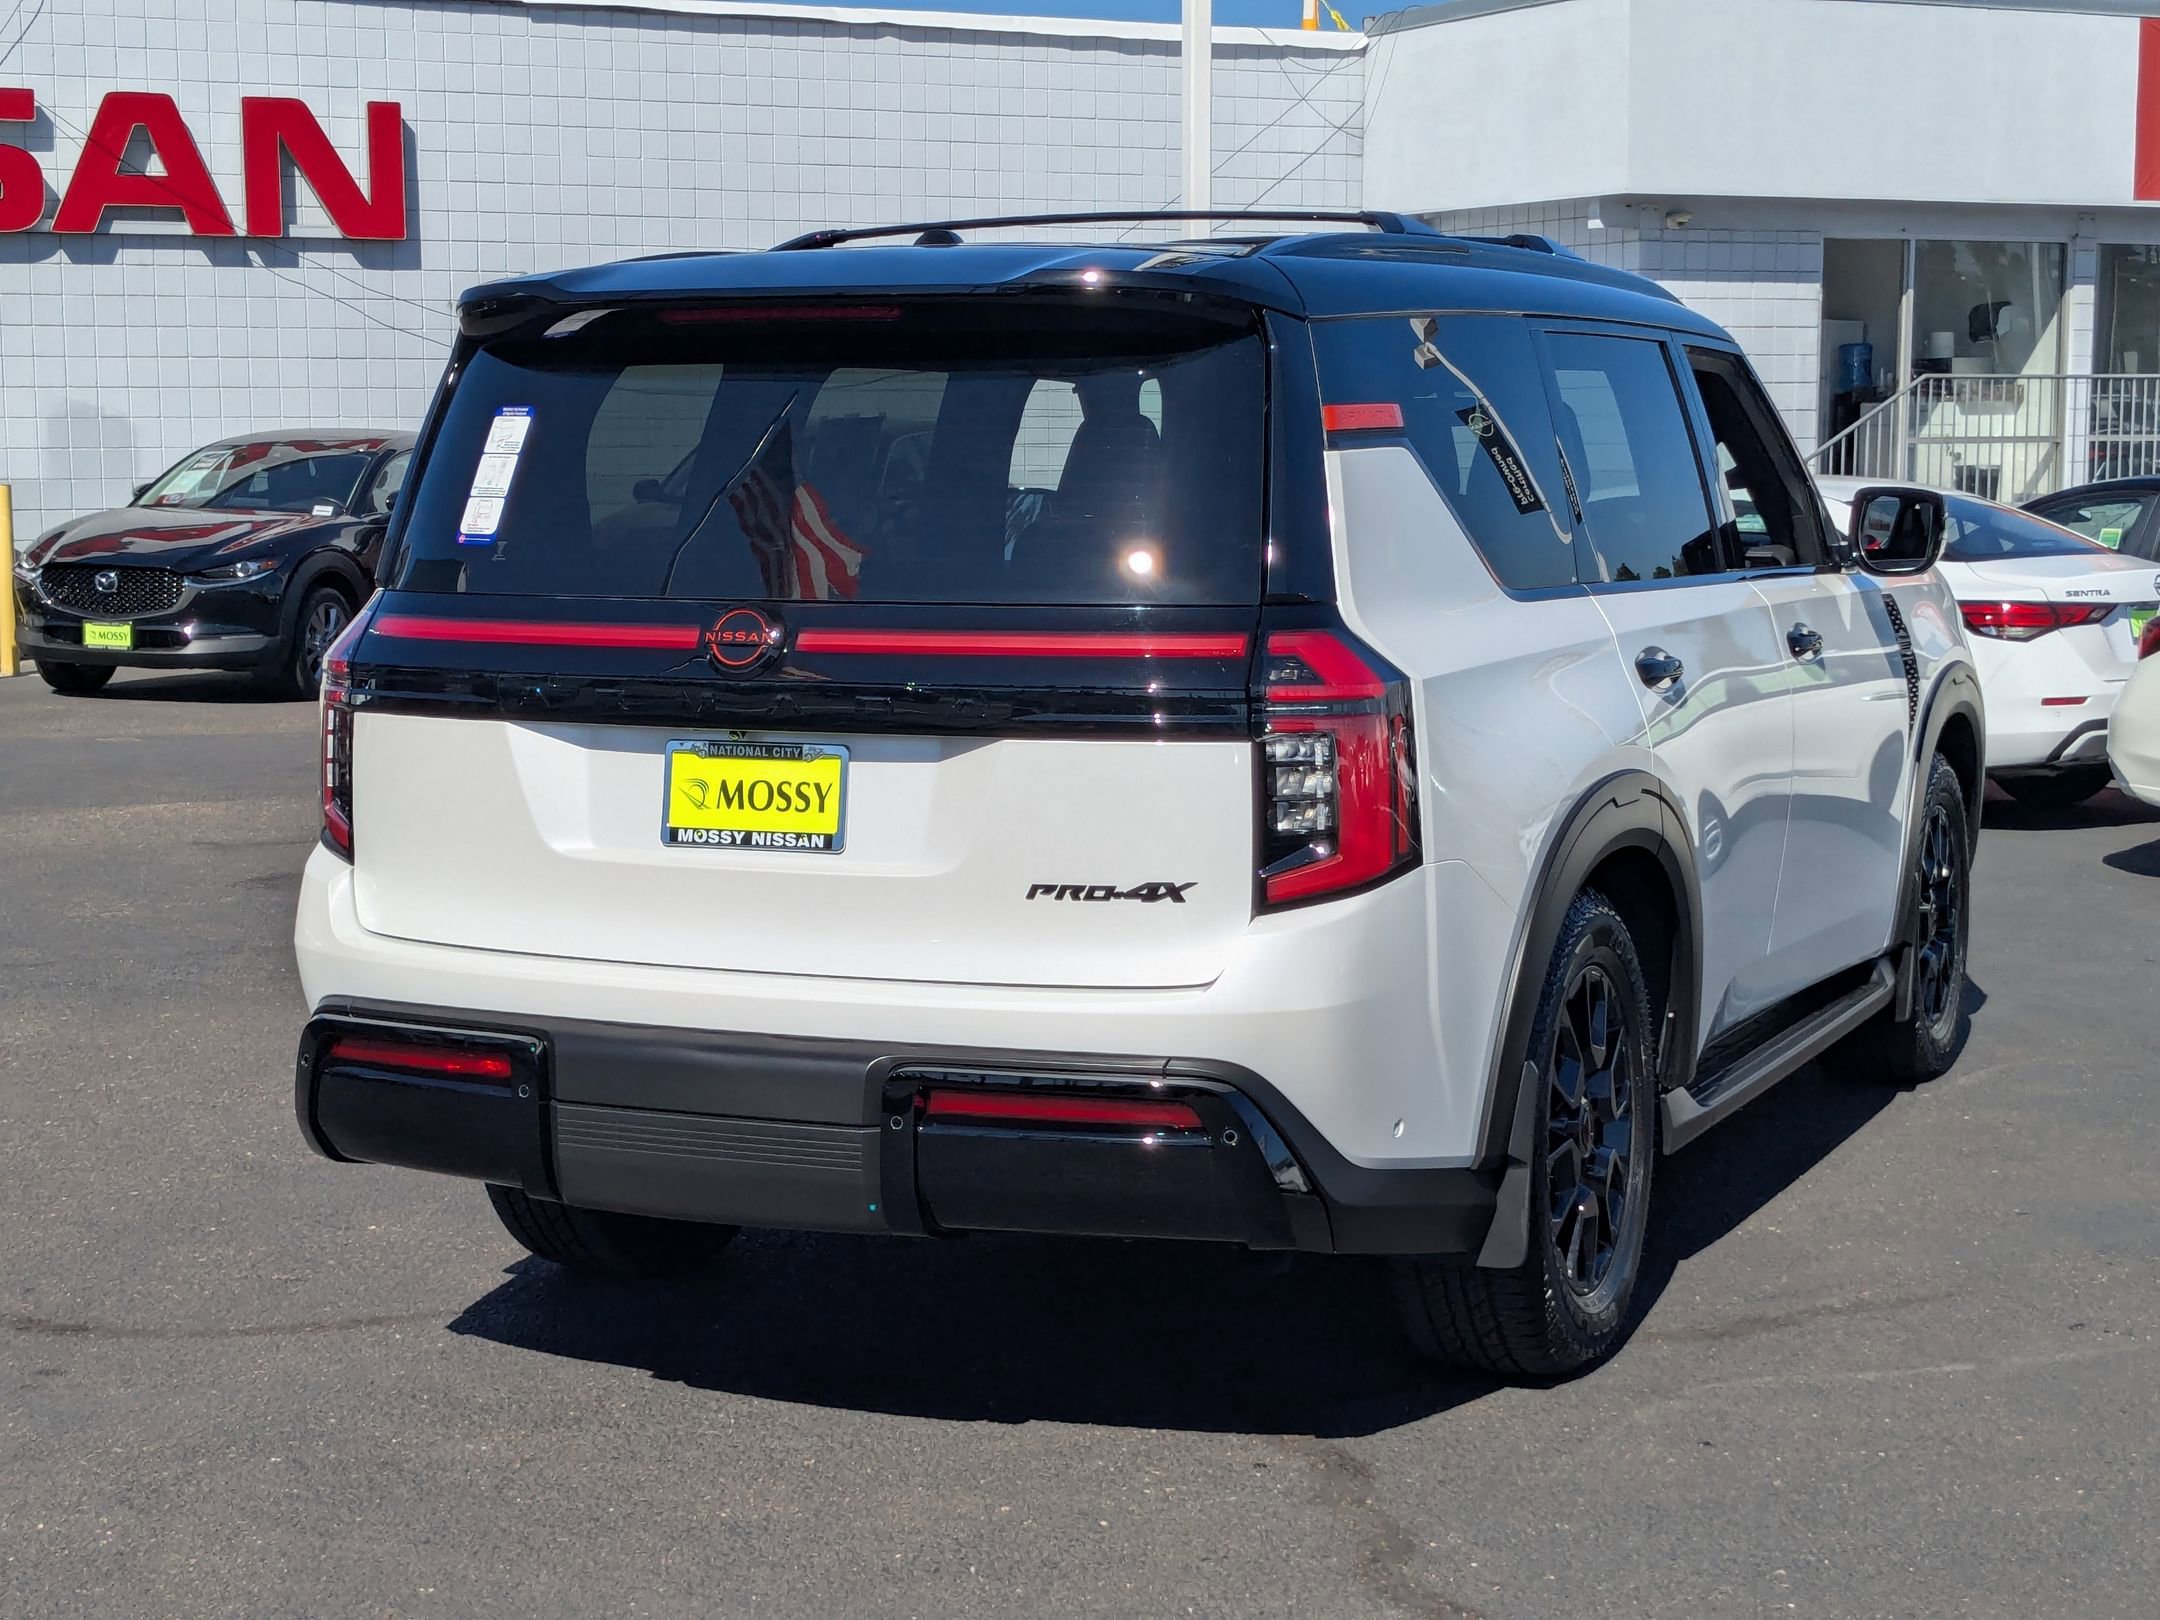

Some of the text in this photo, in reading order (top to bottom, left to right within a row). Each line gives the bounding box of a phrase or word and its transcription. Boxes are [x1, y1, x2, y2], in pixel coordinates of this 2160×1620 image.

[2065, 589, 2111, 598] SENTRA
[98, 631, 128, 641] MOSSY
[705, 631, 774, 644] NISSAN
[709, 745, 803, 759] NATIONAL CITY
[716, 778, 833, 814] MOSSY
[677, 828, 824, 848] MOSSY NISSAN
[1025, 881, 1199, 903] PRO-4X
